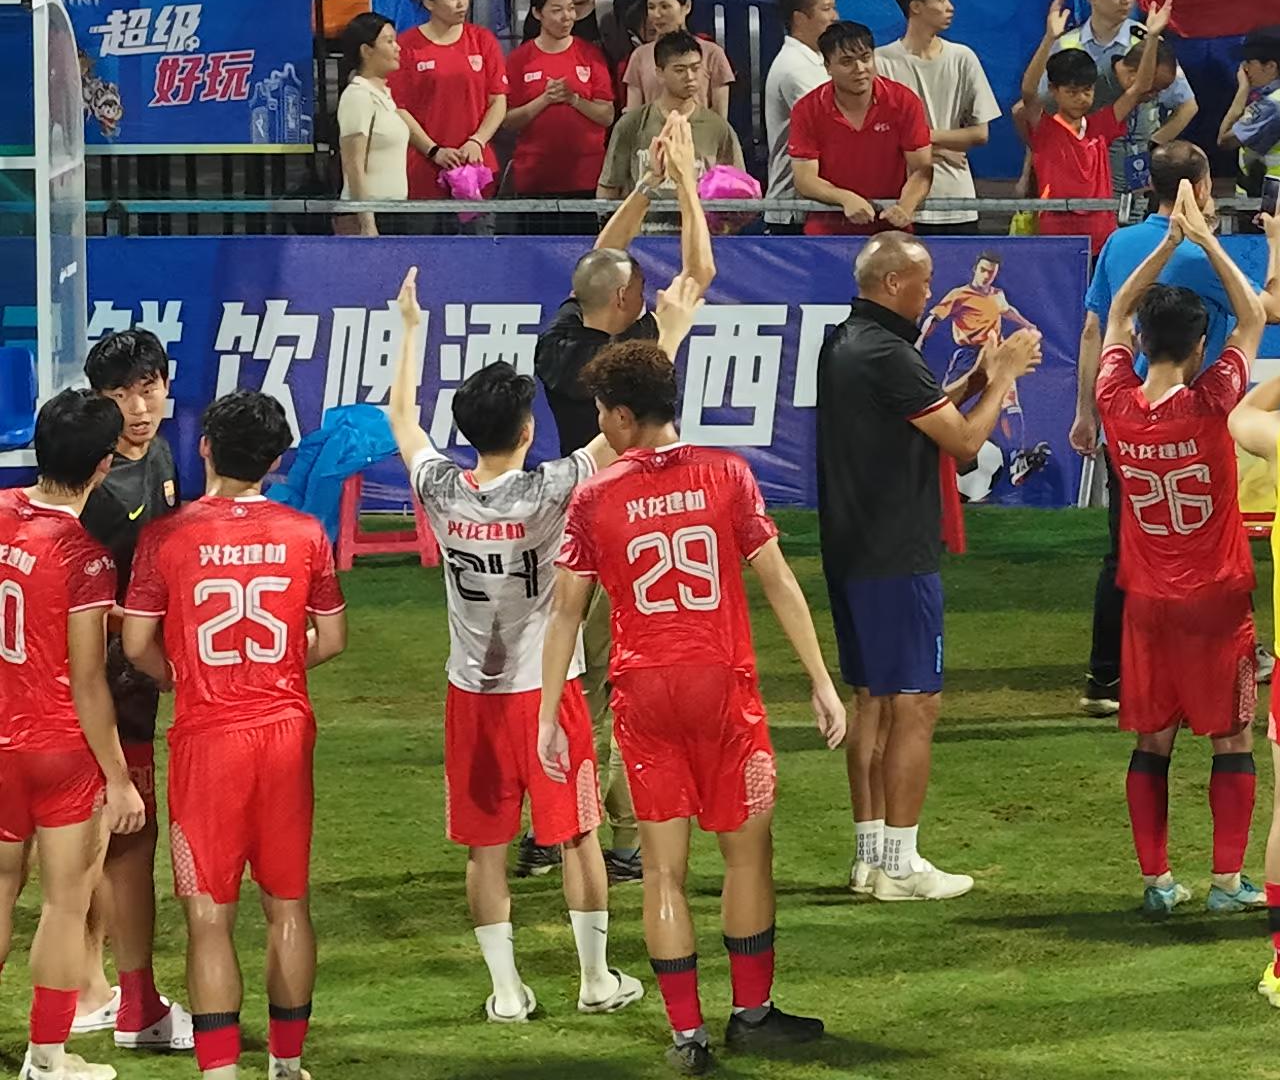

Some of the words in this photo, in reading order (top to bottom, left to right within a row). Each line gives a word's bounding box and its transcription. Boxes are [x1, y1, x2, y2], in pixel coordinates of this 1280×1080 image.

[89, 3, 202, 58] 超级
[148, 49, 255, 107] 好玩
[1120, 463, 1214, 536] 26
[446, 548, 539, 602] 24
[626, 525, 722, 617] 29
[193, 575, 292, 667] 25
